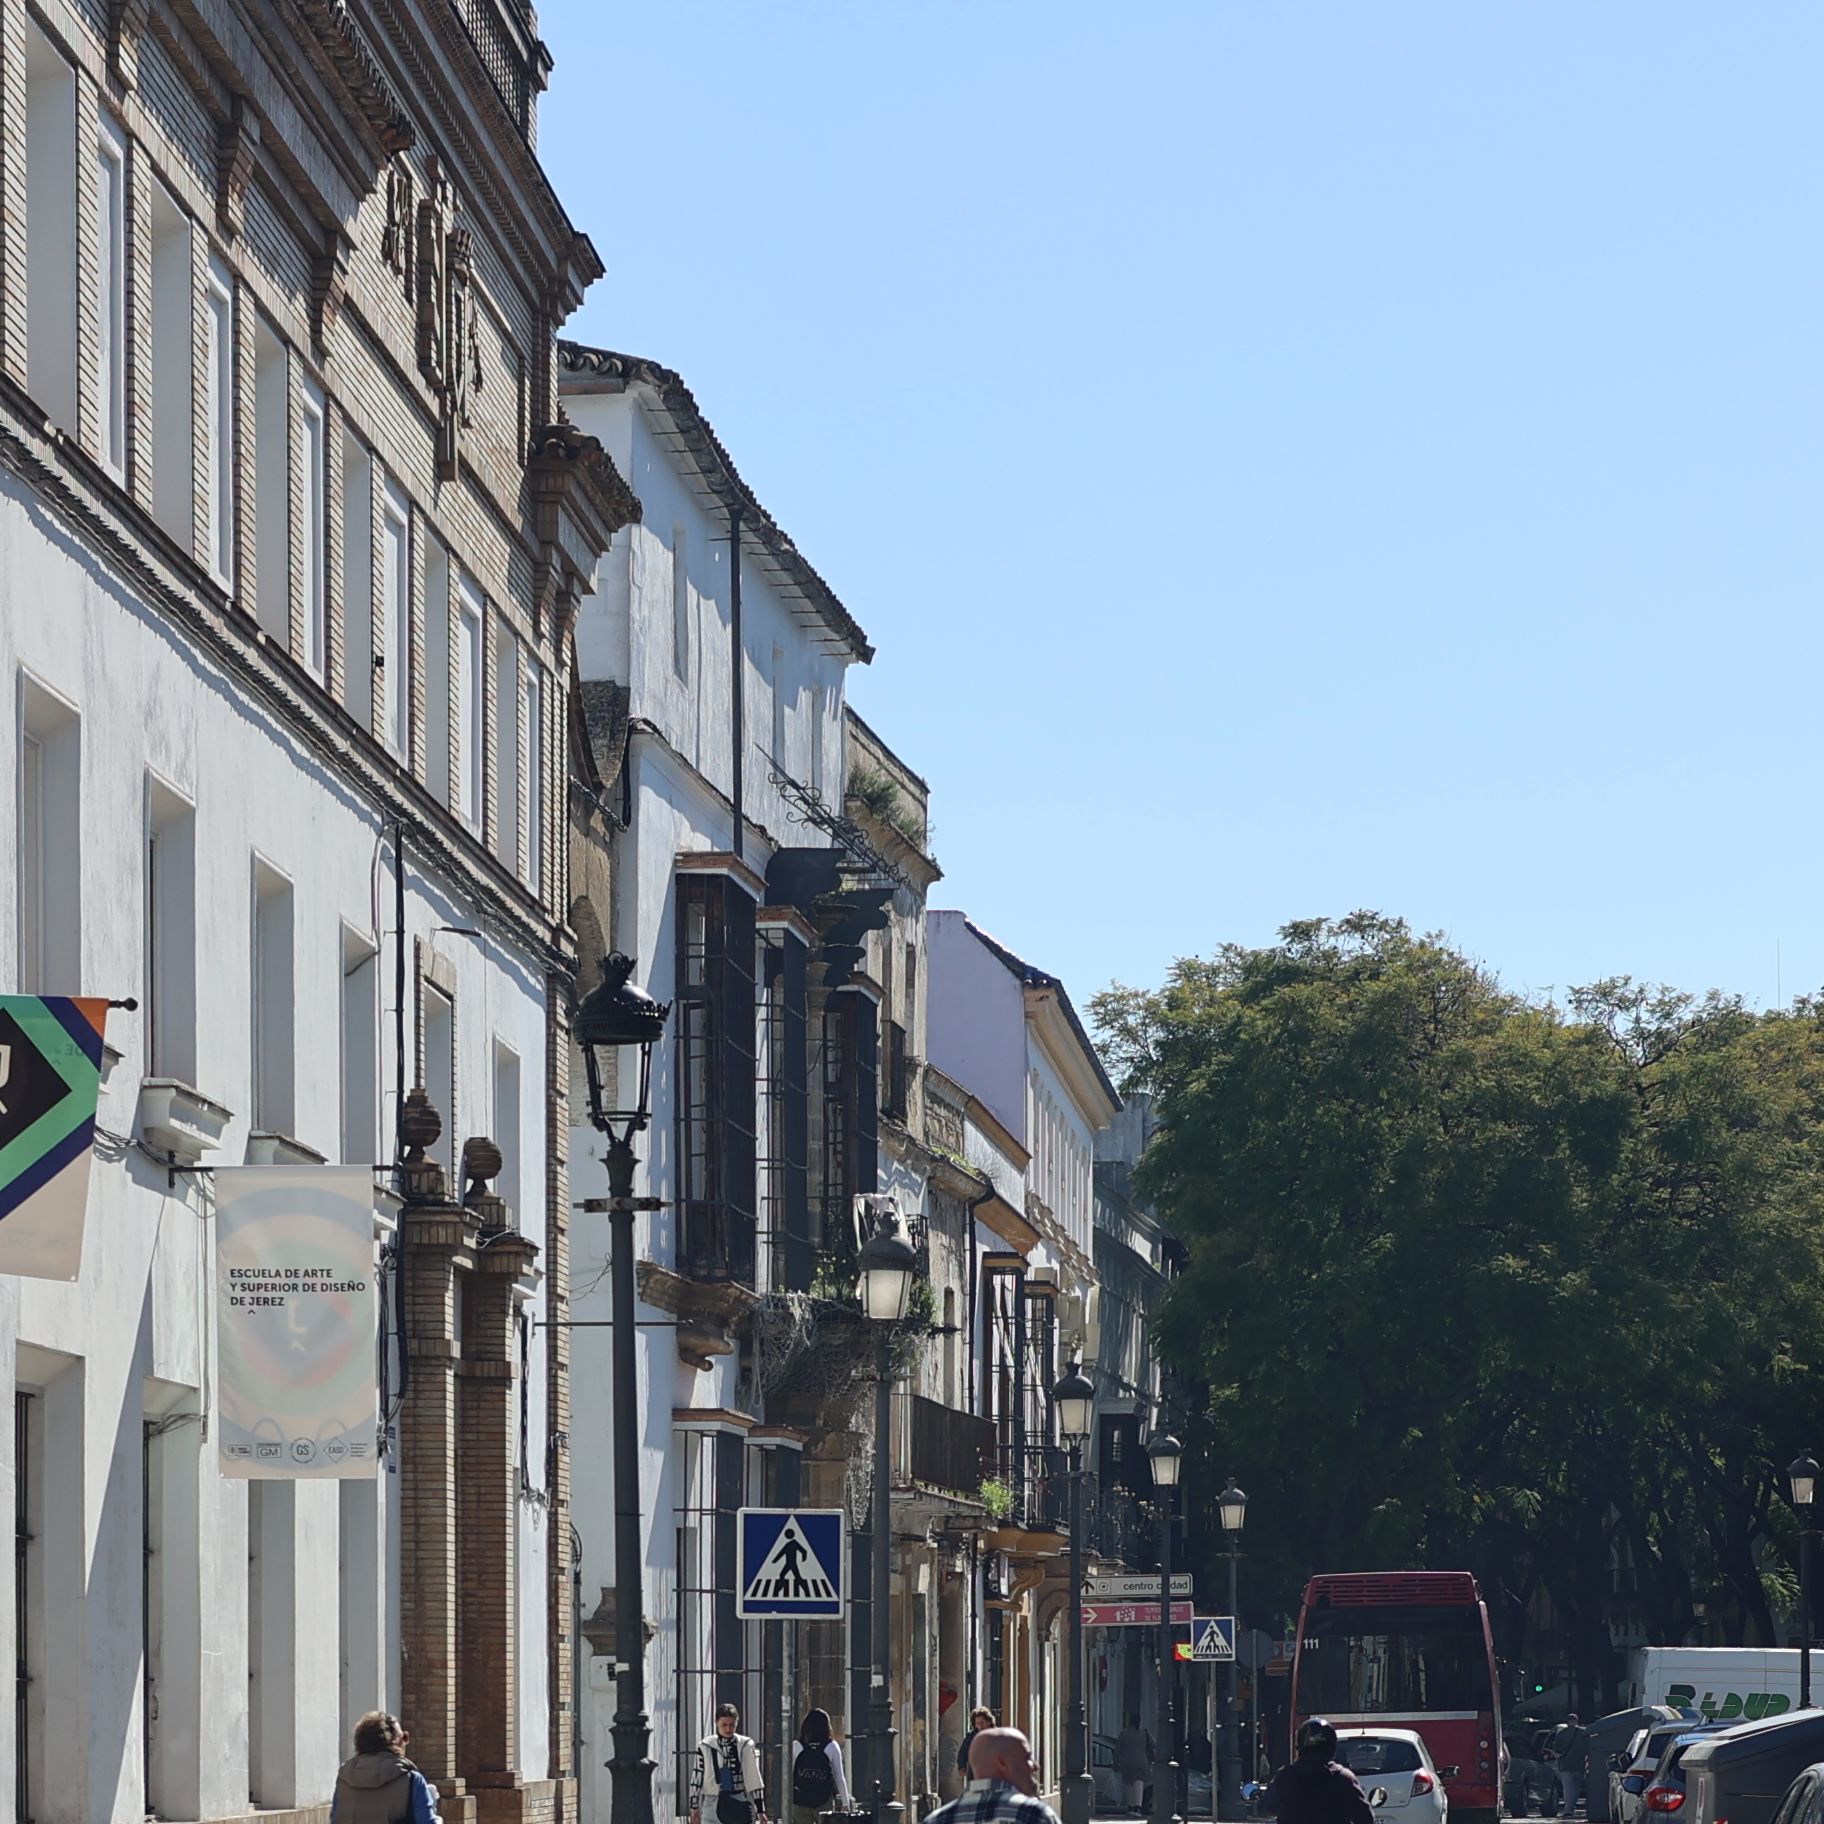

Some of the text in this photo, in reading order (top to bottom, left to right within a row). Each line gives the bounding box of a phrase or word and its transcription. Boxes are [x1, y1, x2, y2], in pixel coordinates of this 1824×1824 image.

[230, 1269, 333, 1278] ESCUELA DE ARTE
[230, 1281, 366, 1292] Y SUPERIOR DE DISEÑO
[230, 1297, 285, 1306] DE JEREZ
[296, 1444, 310, 1456] GS
[1123, 1580, 1188, 1590] centro cdad
[1304, 1638, 1319, 1650] 111
